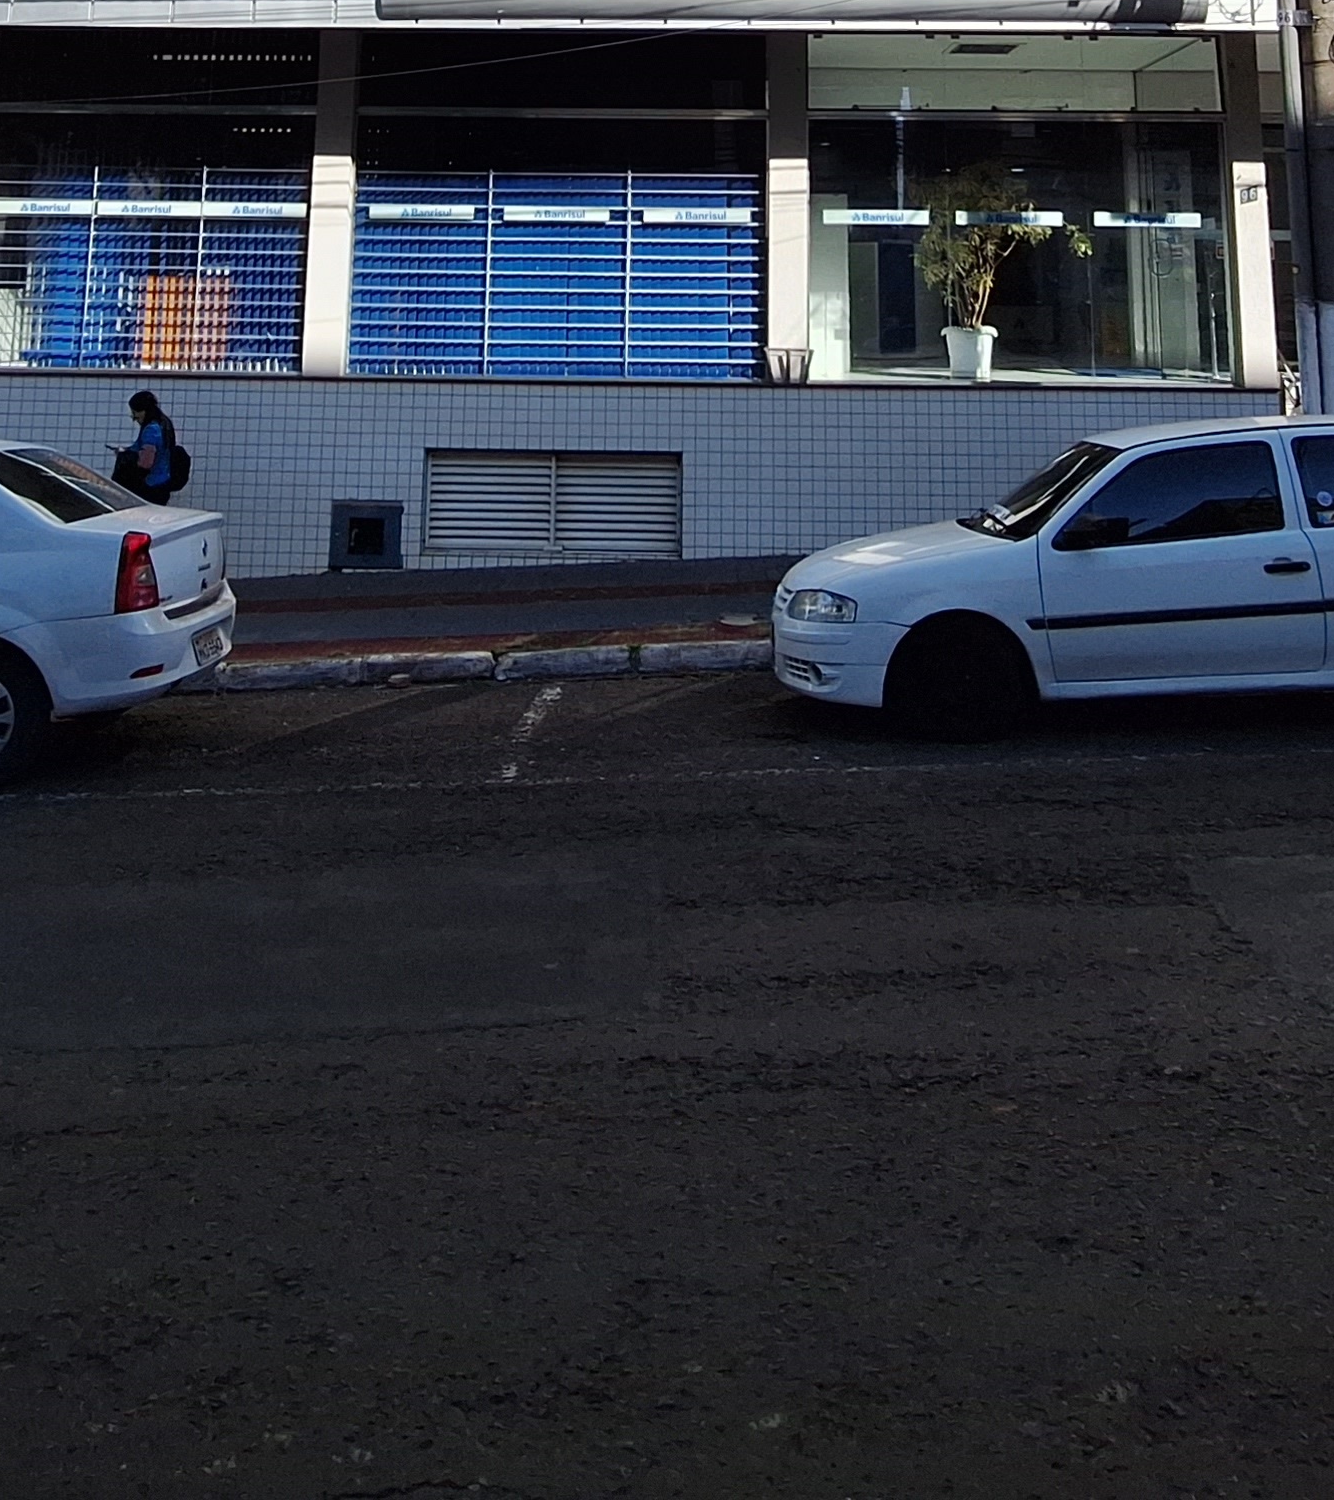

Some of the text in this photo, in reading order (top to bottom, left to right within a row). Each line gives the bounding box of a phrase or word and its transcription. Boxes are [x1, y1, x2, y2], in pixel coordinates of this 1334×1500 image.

[1241, 187, 1257, 203] 96
[30, 202, 71, 212] Banrisul
[131, 204, 172, 214] Banrisul
[241, 205, 283, 215] Banrisul
[411, 207, 452, 217] Banrisul
[543, 209, 586, 219] Banrisul
[685, 210, 727, 221] Banrisul
[862, 212, 904, 222] Banrisul
